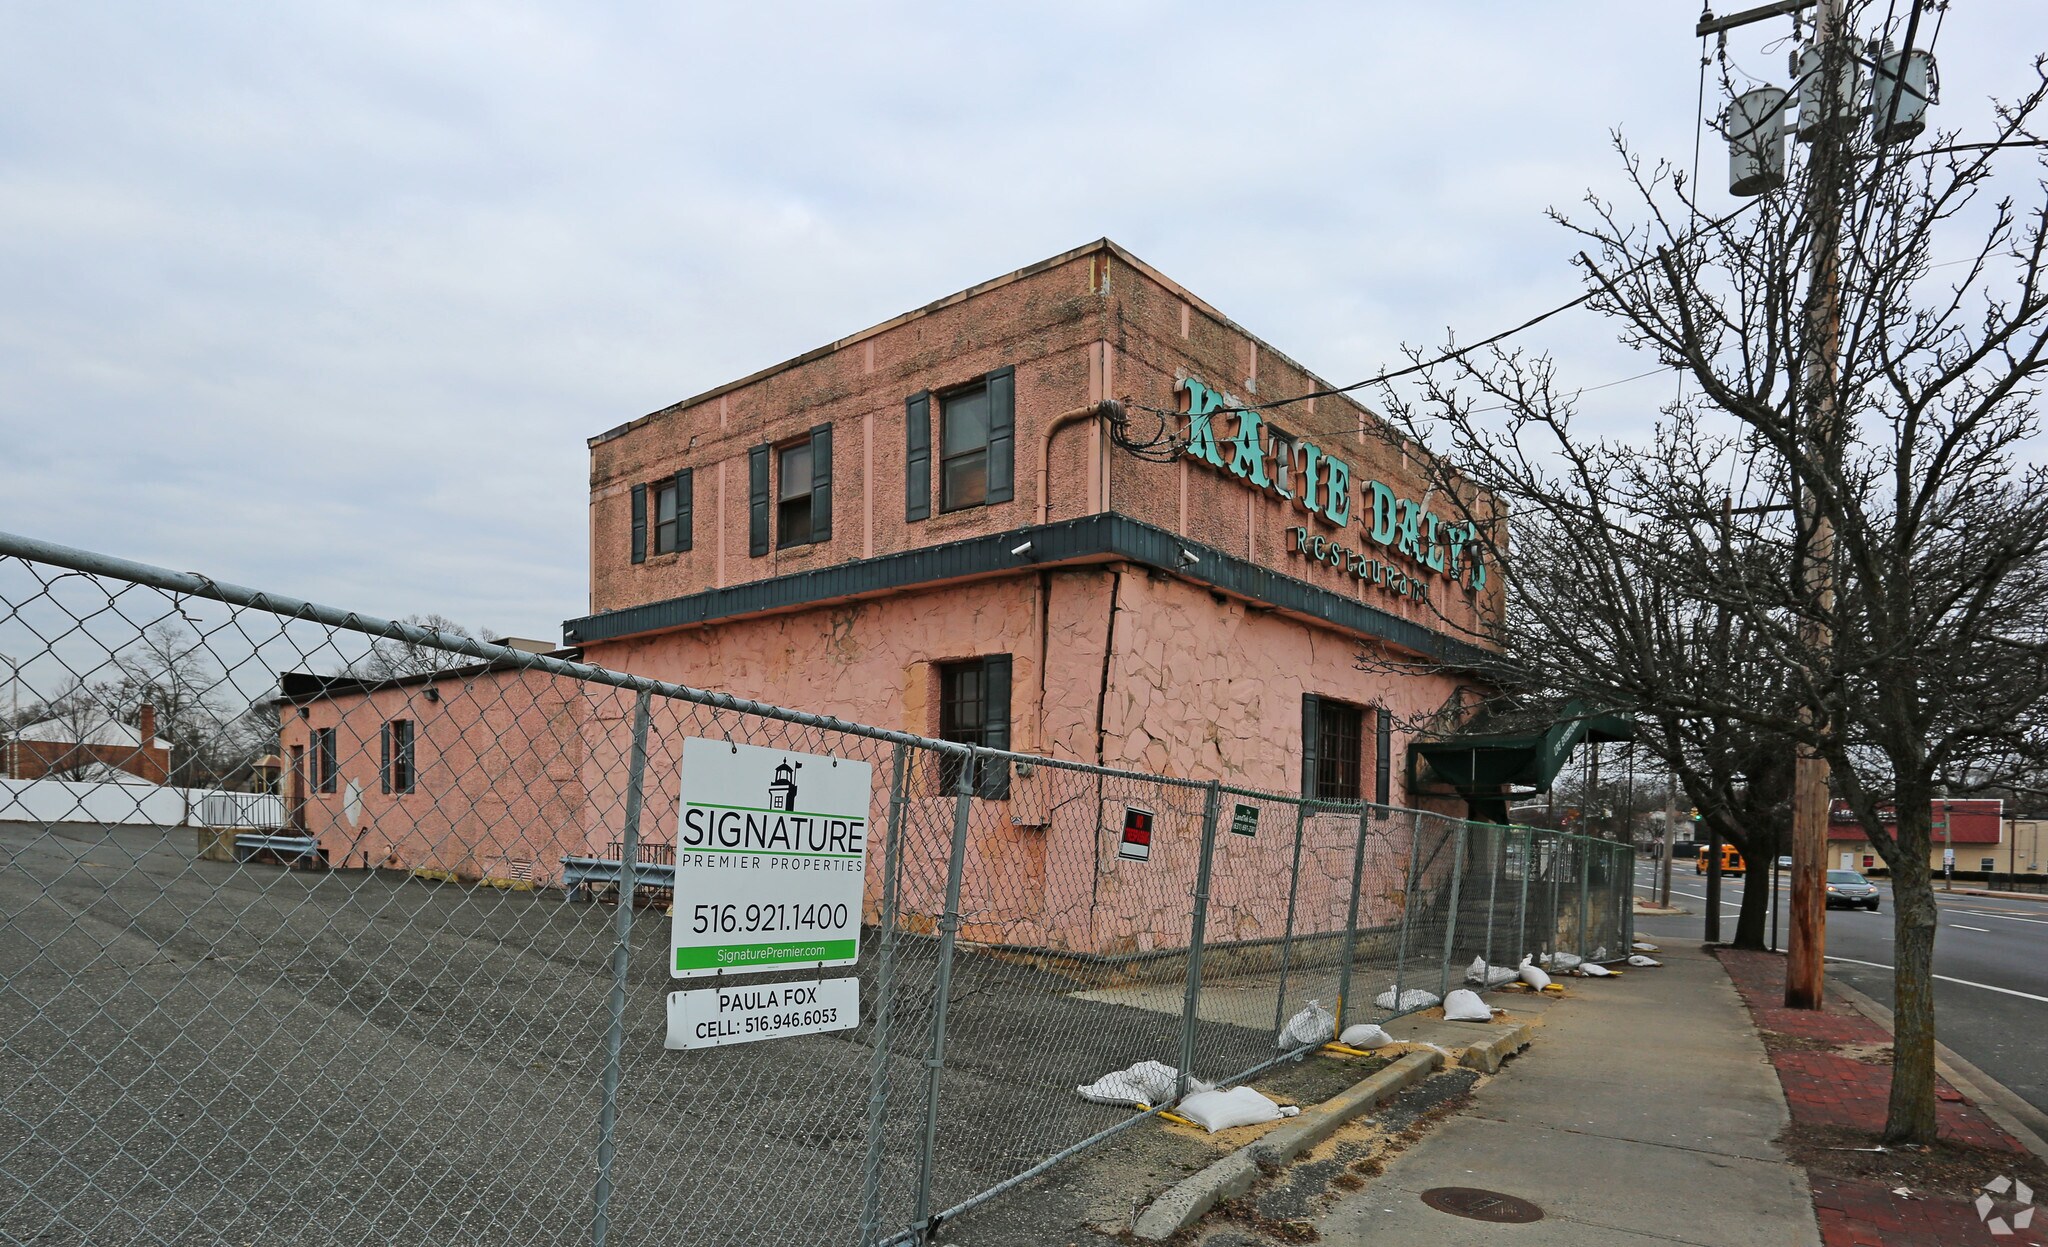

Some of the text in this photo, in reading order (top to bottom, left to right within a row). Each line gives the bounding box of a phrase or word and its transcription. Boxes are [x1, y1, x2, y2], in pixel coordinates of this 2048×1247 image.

[682, 808, 865, 854] SIGNATURE
[681, 854, 863, 873] PREMIER PROPERTIES
[692, 903, 848, 935] 516.921.1400
[716, 944, 826, 964] SignaturePremier.com
[718, 986, 818, 1013] PAULA FOX
[695, 1007, 838, 1040] CELL: 516.946.6053
